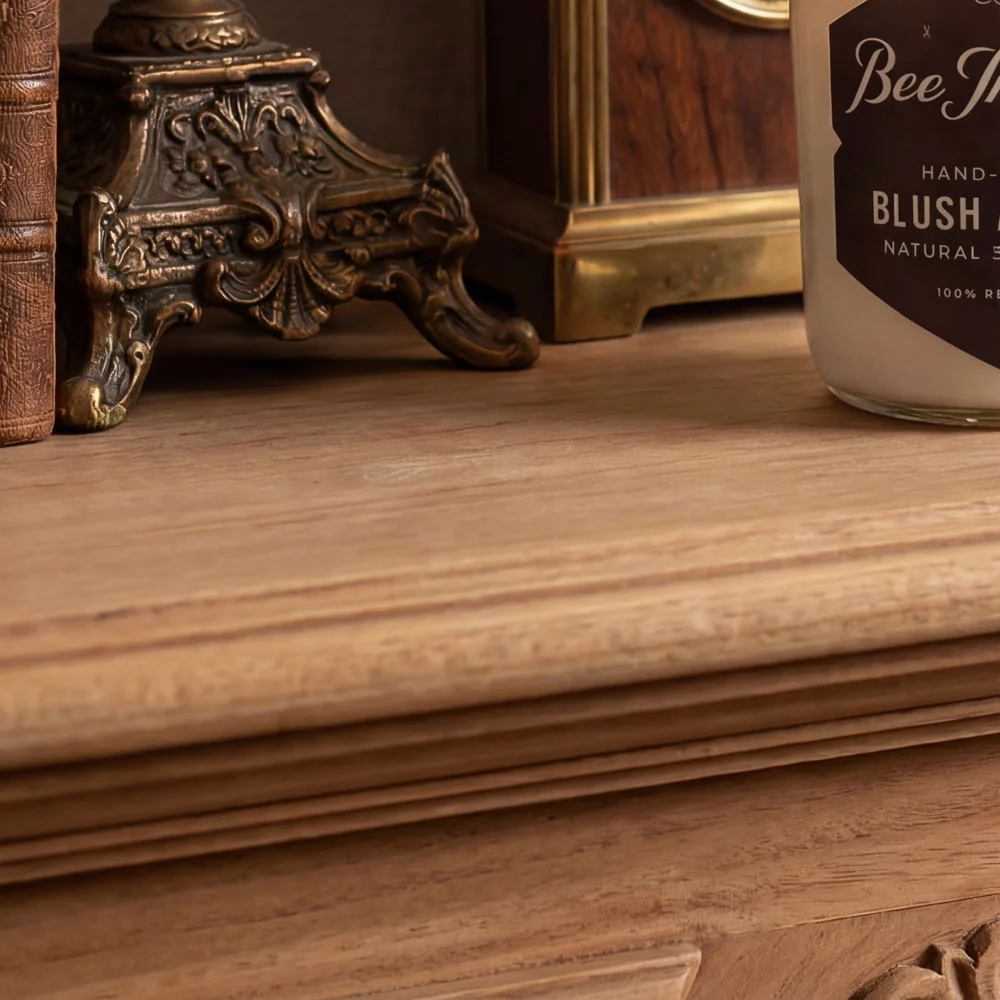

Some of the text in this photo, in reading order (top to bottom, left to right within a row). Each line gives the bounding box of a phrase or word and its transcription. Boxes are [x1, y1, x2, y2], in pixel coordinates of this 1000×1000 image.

[845, 37, 946, 114] Bee
[872, 190, 980, 231] BLUSH
[884, 239, 980, 260] NATURAL
[936, 287, 977, 299] 100%
